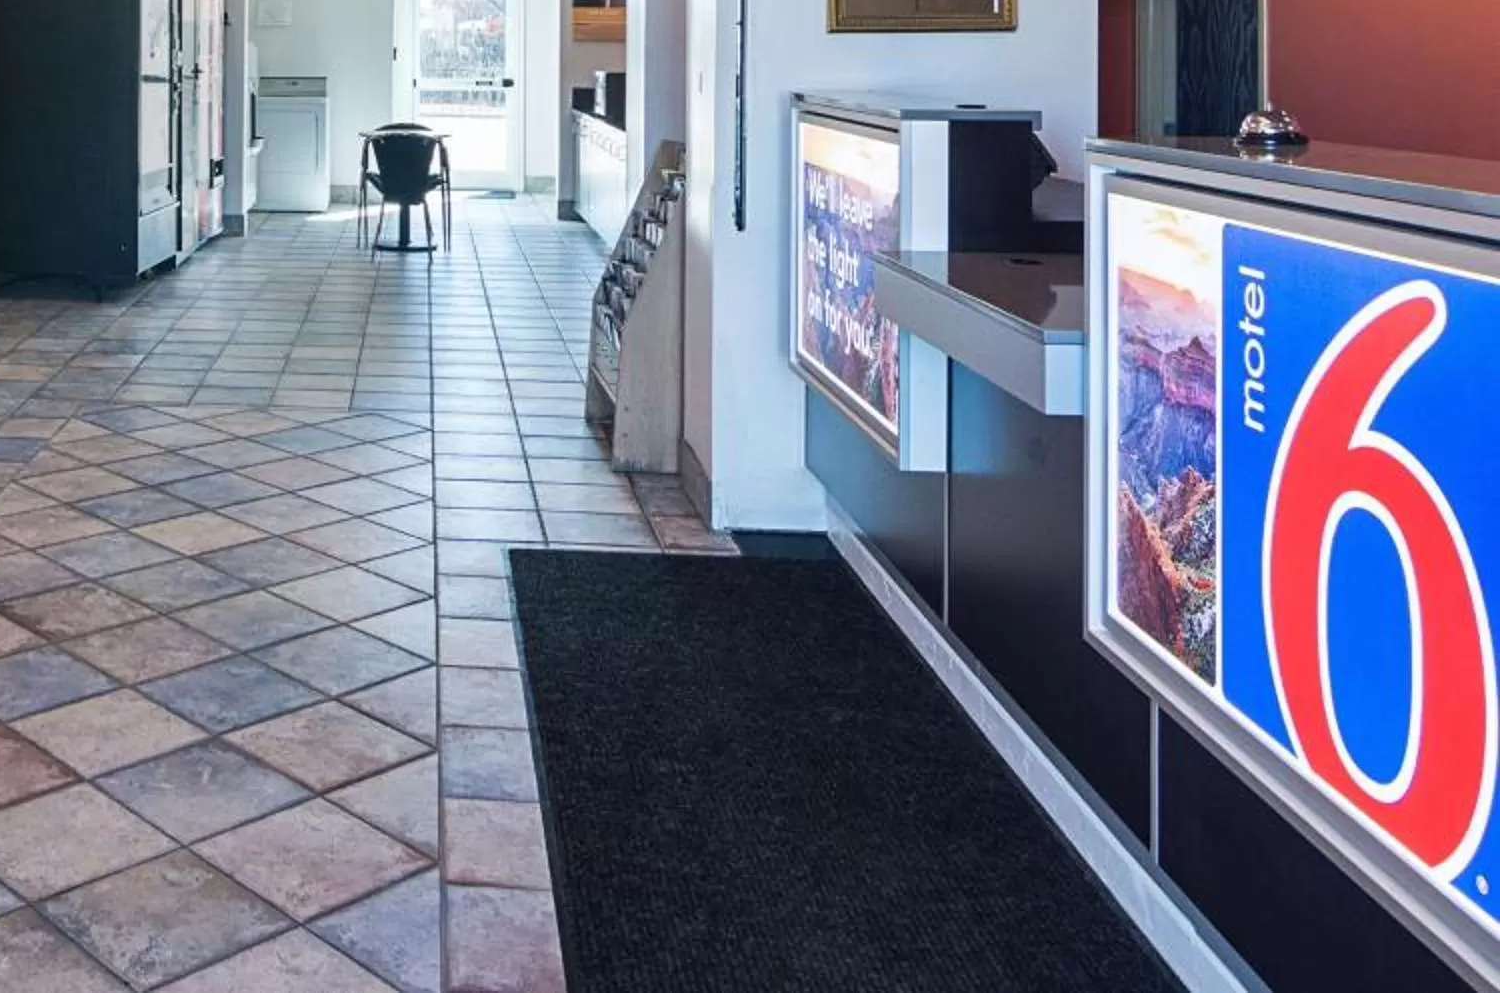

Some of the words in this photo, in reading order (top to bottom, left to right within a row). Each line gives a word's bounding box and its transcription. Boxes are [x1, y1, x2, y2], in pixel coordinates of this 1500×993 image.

[807, 166, 835, 213] We'll
[839, 176, 873, 231] leave
[808, 224, 826, 267] the
[829, 229, 858, 290] light
[808, 291, 823, 321] on
[824, 288, 843, 335] for
[1238, 265, 1265, 433] motel
[1263, 279, 1499, 883] 6
